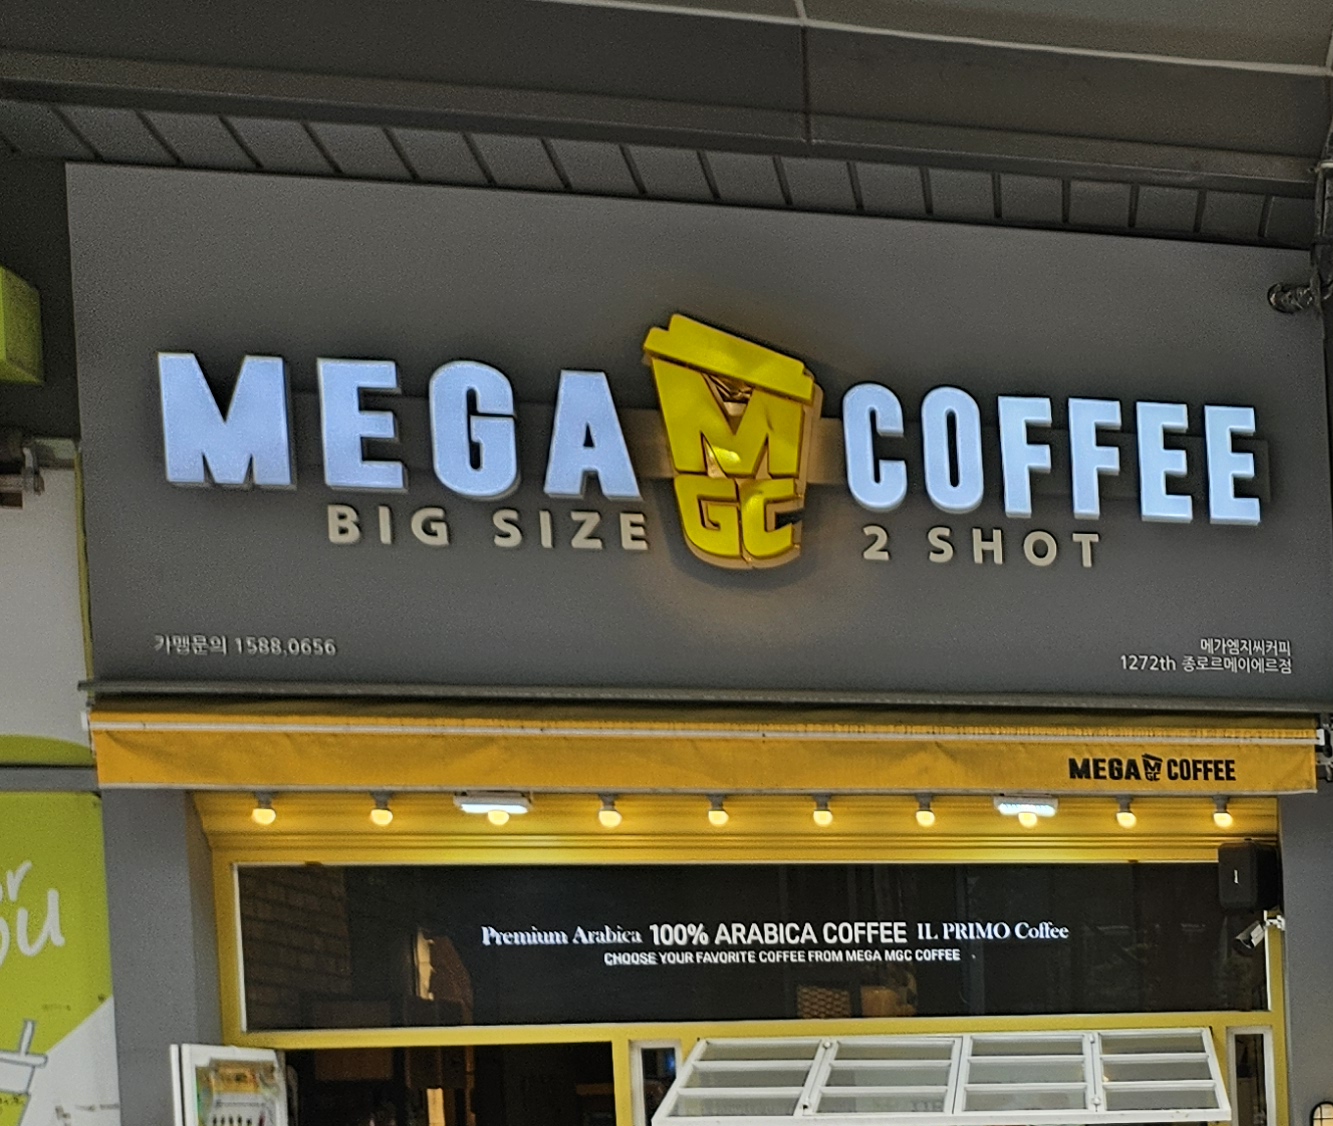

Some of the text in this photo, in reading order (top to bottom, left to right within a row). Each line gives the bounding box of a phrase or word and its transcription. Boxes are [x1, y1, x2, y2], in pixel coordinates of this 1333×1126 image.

[157, 352, 643, 502] MEGA
[843, 383, 1262, 525] COFFEE
[328, 504, 649, 552] BIG SIZE
[862, 525, 1100, 567] 2 SHOT
[154, 635, 228, 655] 가맹문의
[1200, 638, 1291, 656] 메가엠지씨커피
[1120, 655, 1292, 674] 1272th 종로르메이에르점
[1068, 758, 1141, 781] MEGA
[1167, 759, 1236, 781] COFFEE
[481, 921, 1070, 945] Premium Arabica 100% ARABICA COFFEE IL PRIMO Coffee
[604, 949, 960, 965] CHOOSE YOUR FAVORITE COFFEE FROM MEGA MGC COFFEE
